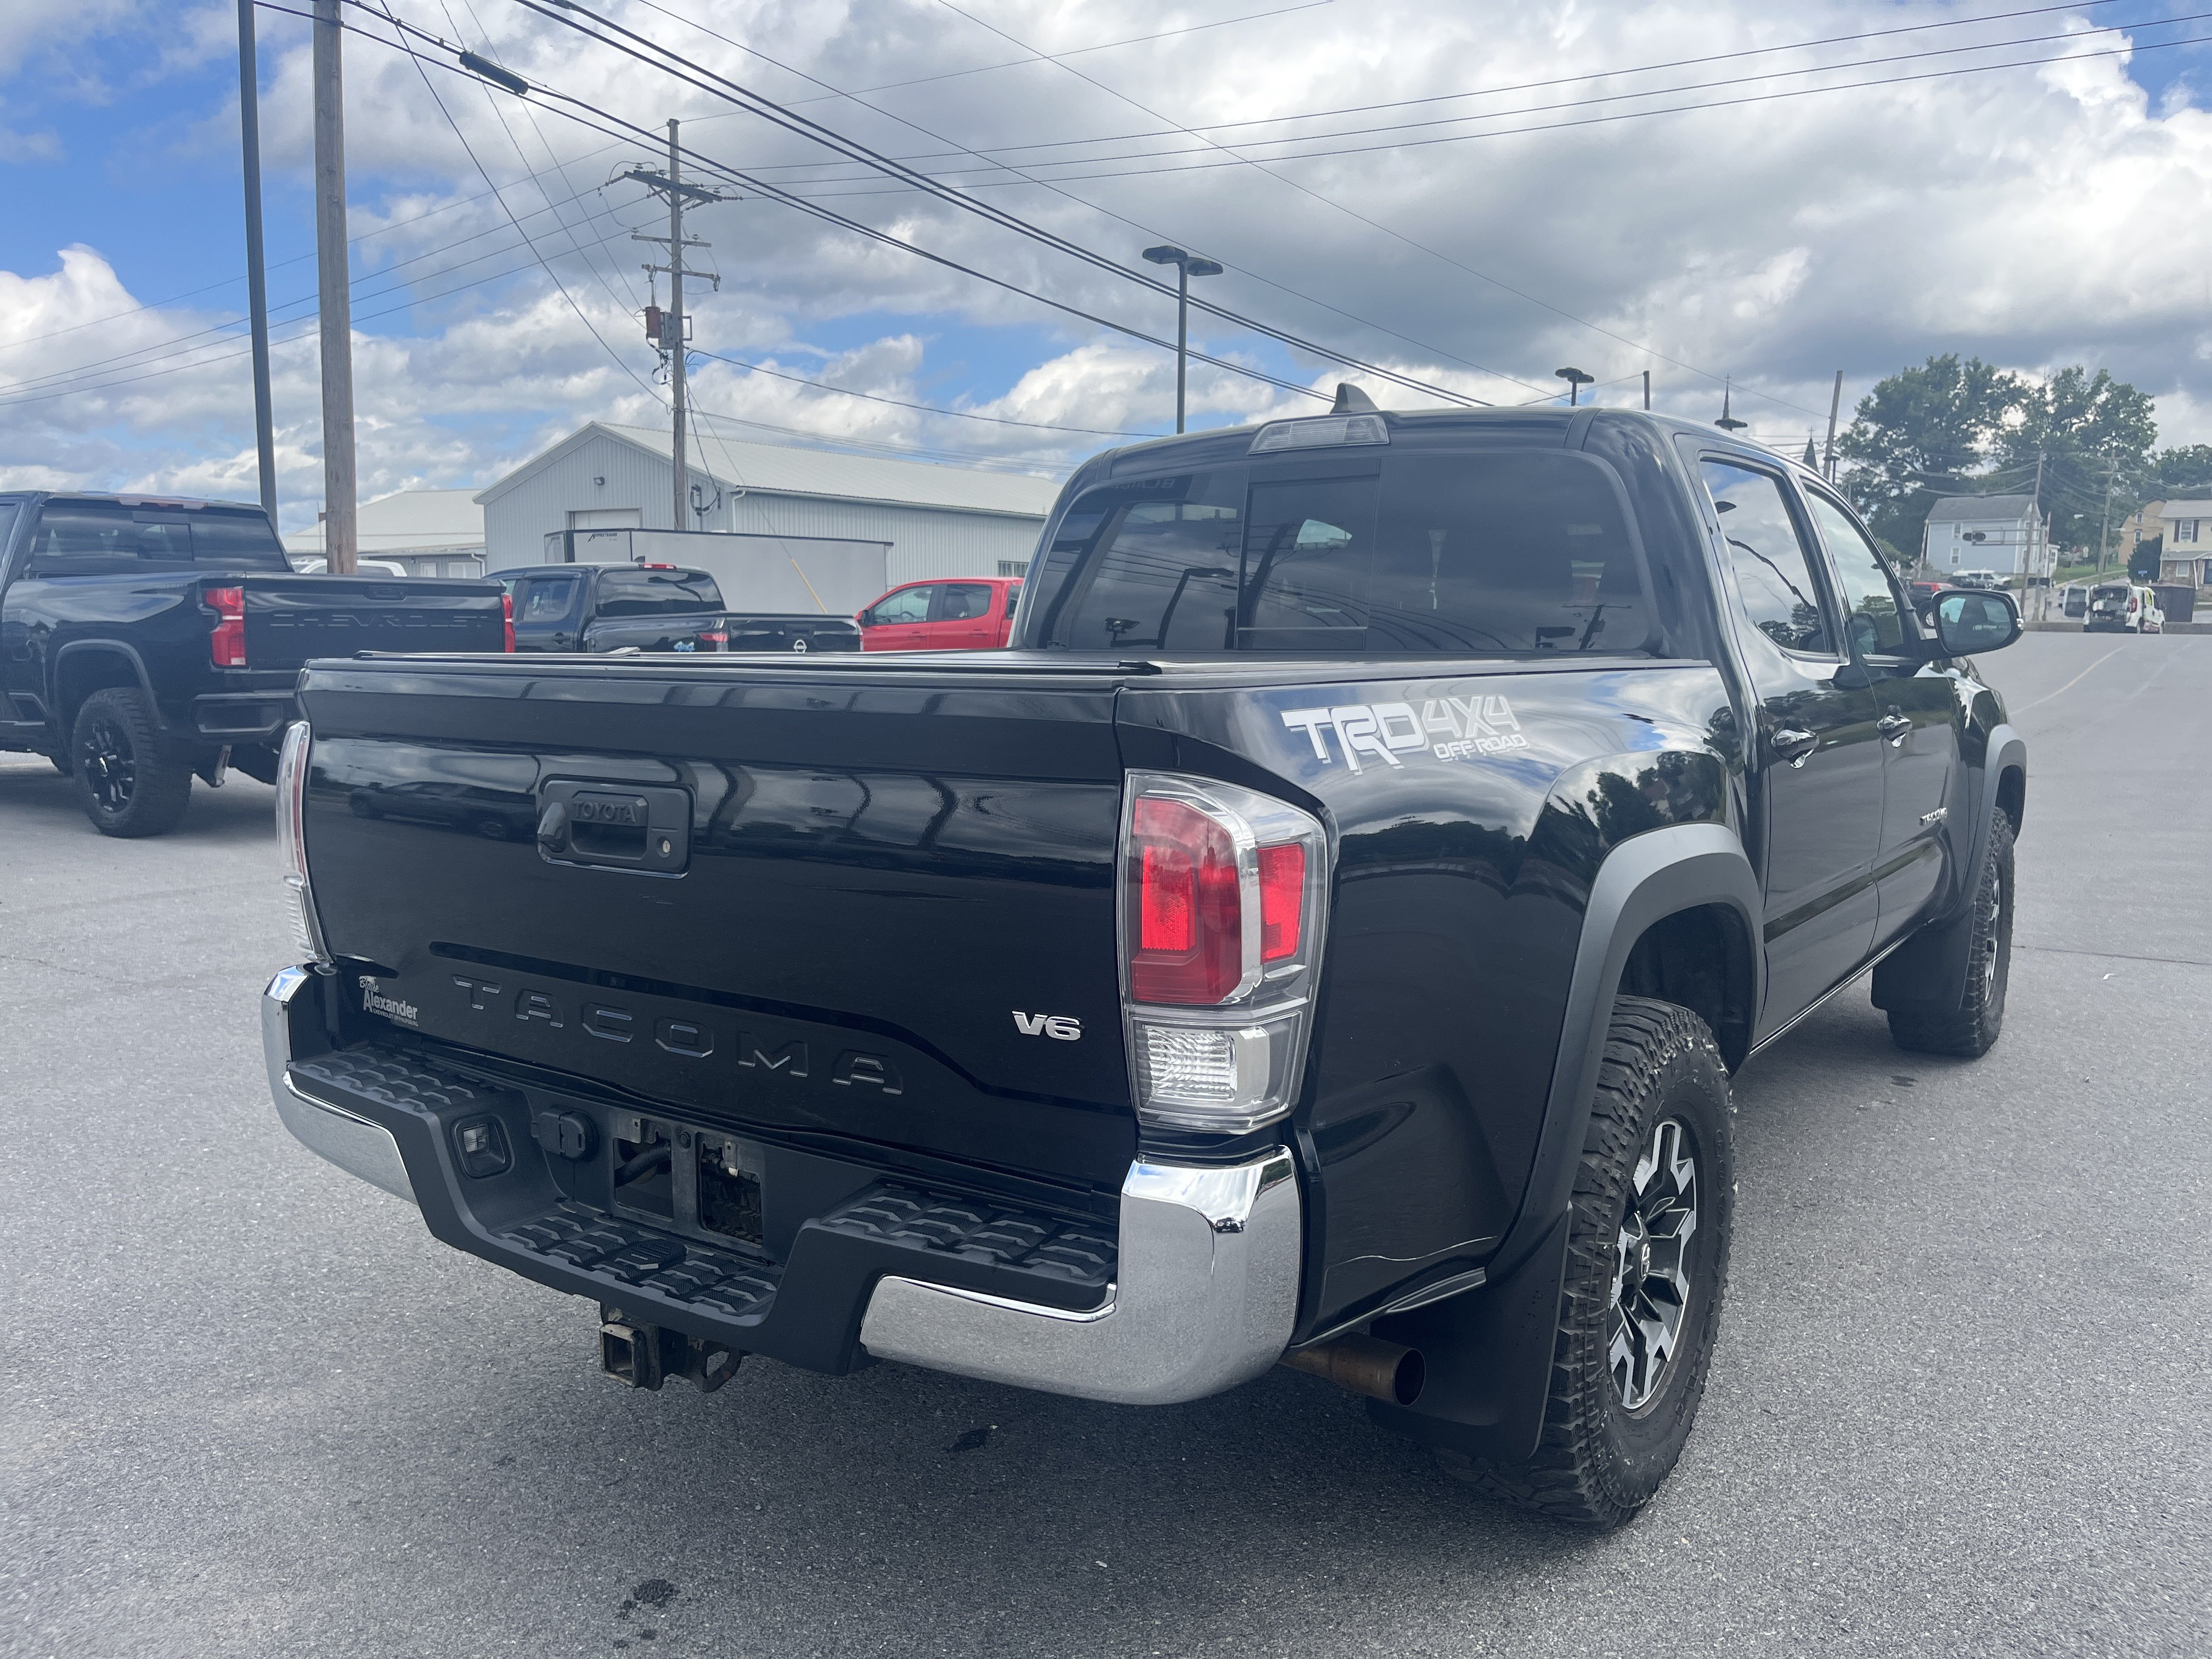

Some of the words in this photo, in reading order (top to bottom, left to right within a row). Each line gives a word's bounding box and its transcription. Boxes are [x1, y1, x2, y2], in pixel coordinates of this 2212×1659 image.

[270, 614, 488, 628] CHEVROLET
[1280, 702, 1428, 775] TRD
[1432, 741, 1475, 762] OFF
[1474, 733, 1531, 755] ROAD
[573, 800, 637, 823] TOYOTA
[363, 989, 418, 1020] Alexander
[452, 973, 904, 1096] TACOMA
[1012, 1011, 1081, 1041] V6
